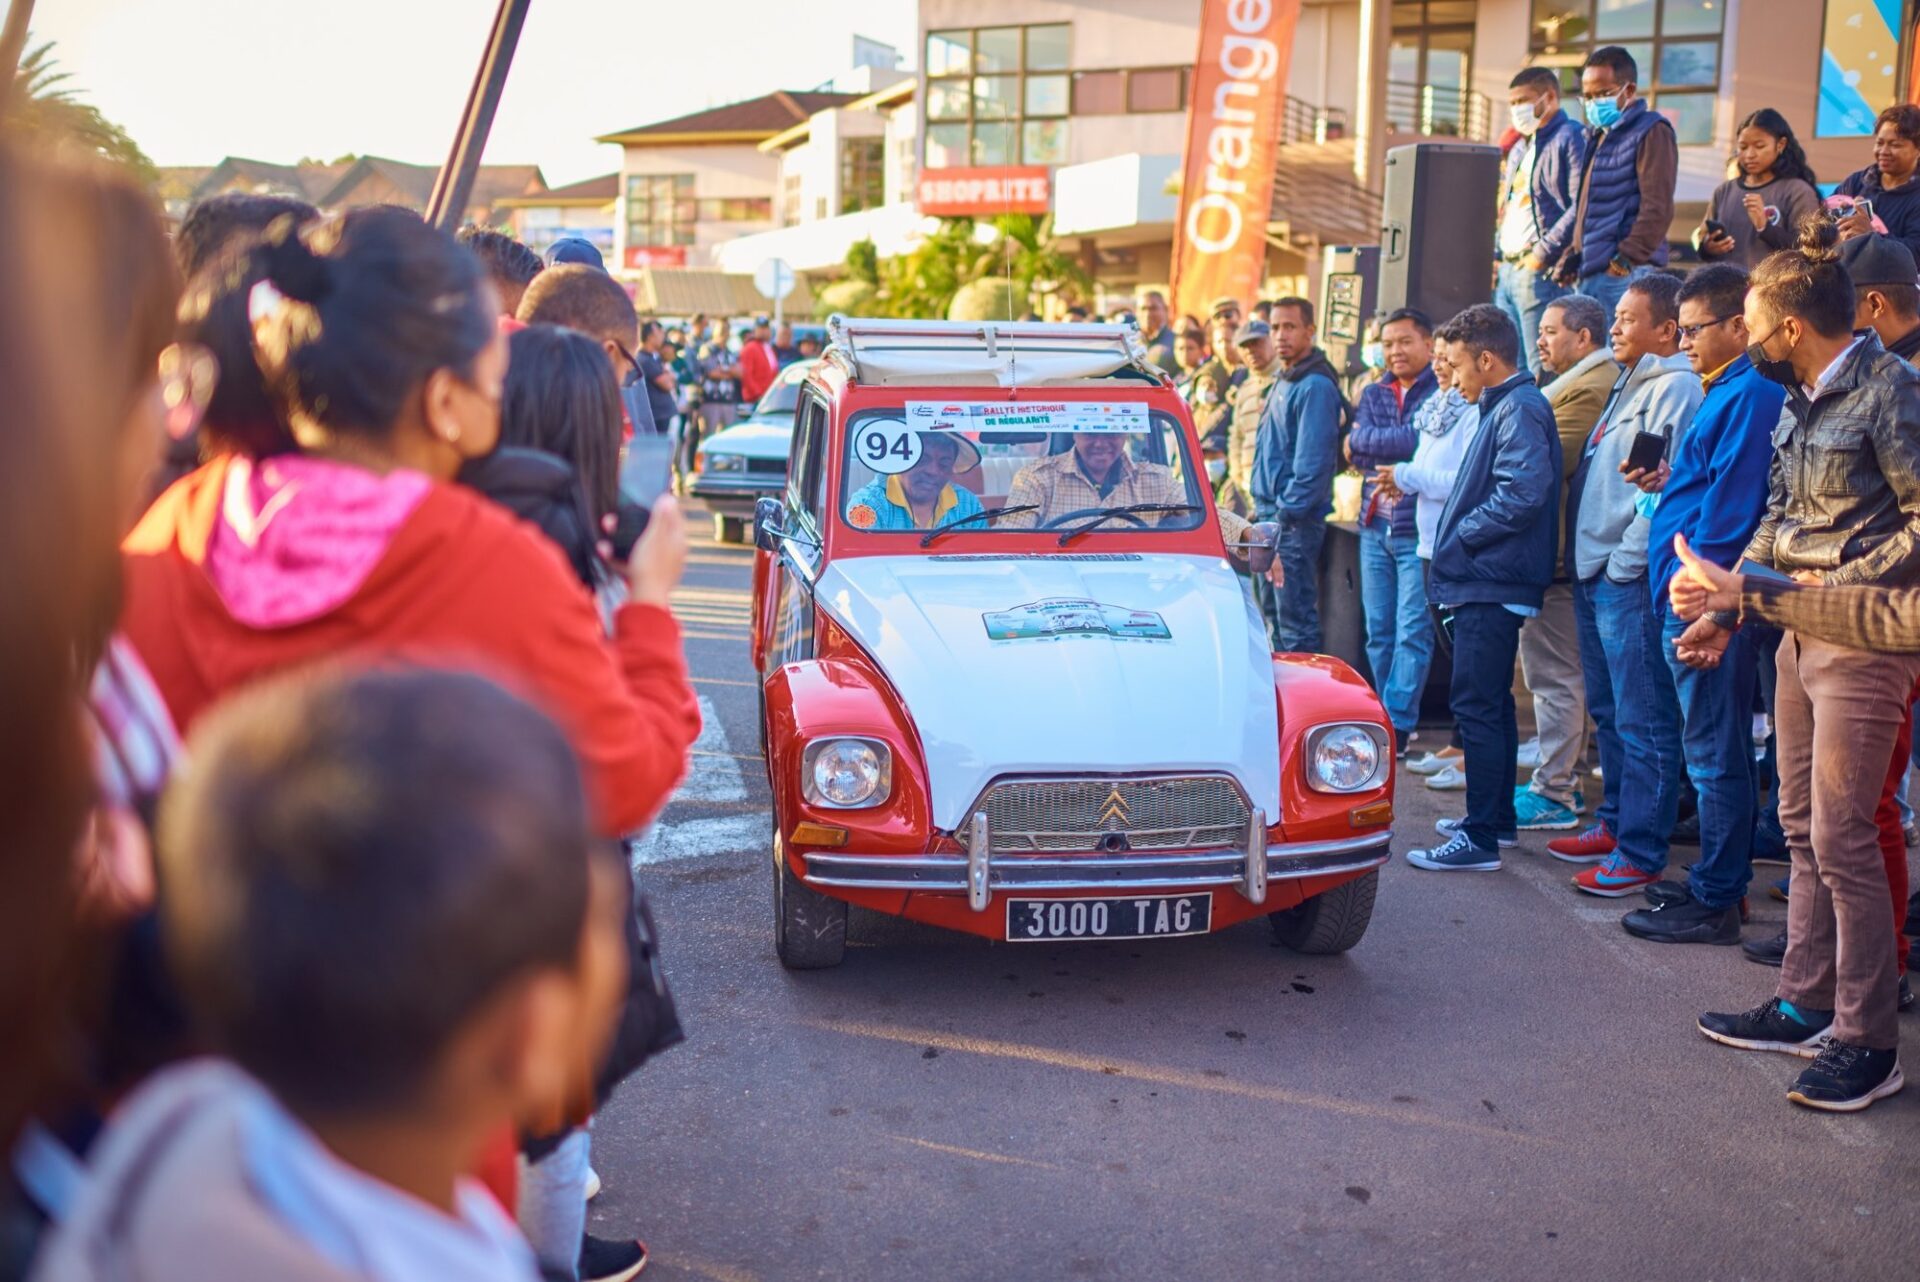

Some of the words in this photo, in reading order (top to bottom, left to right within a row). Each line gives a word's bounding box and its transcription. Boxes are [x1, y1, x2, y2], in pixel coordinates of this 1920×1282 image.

[1186, 0, 1279, 254] Orange
[919, 178, 1047, 204] SHOPRITE
[983, 406, 1015, 416] RALLYE
[985, 417, 996, 426] DE
[866, 432, 913, 461] 94
[1028, 902, 1109, 937] 3000
[1134, 899, 1192, 934] TAG
